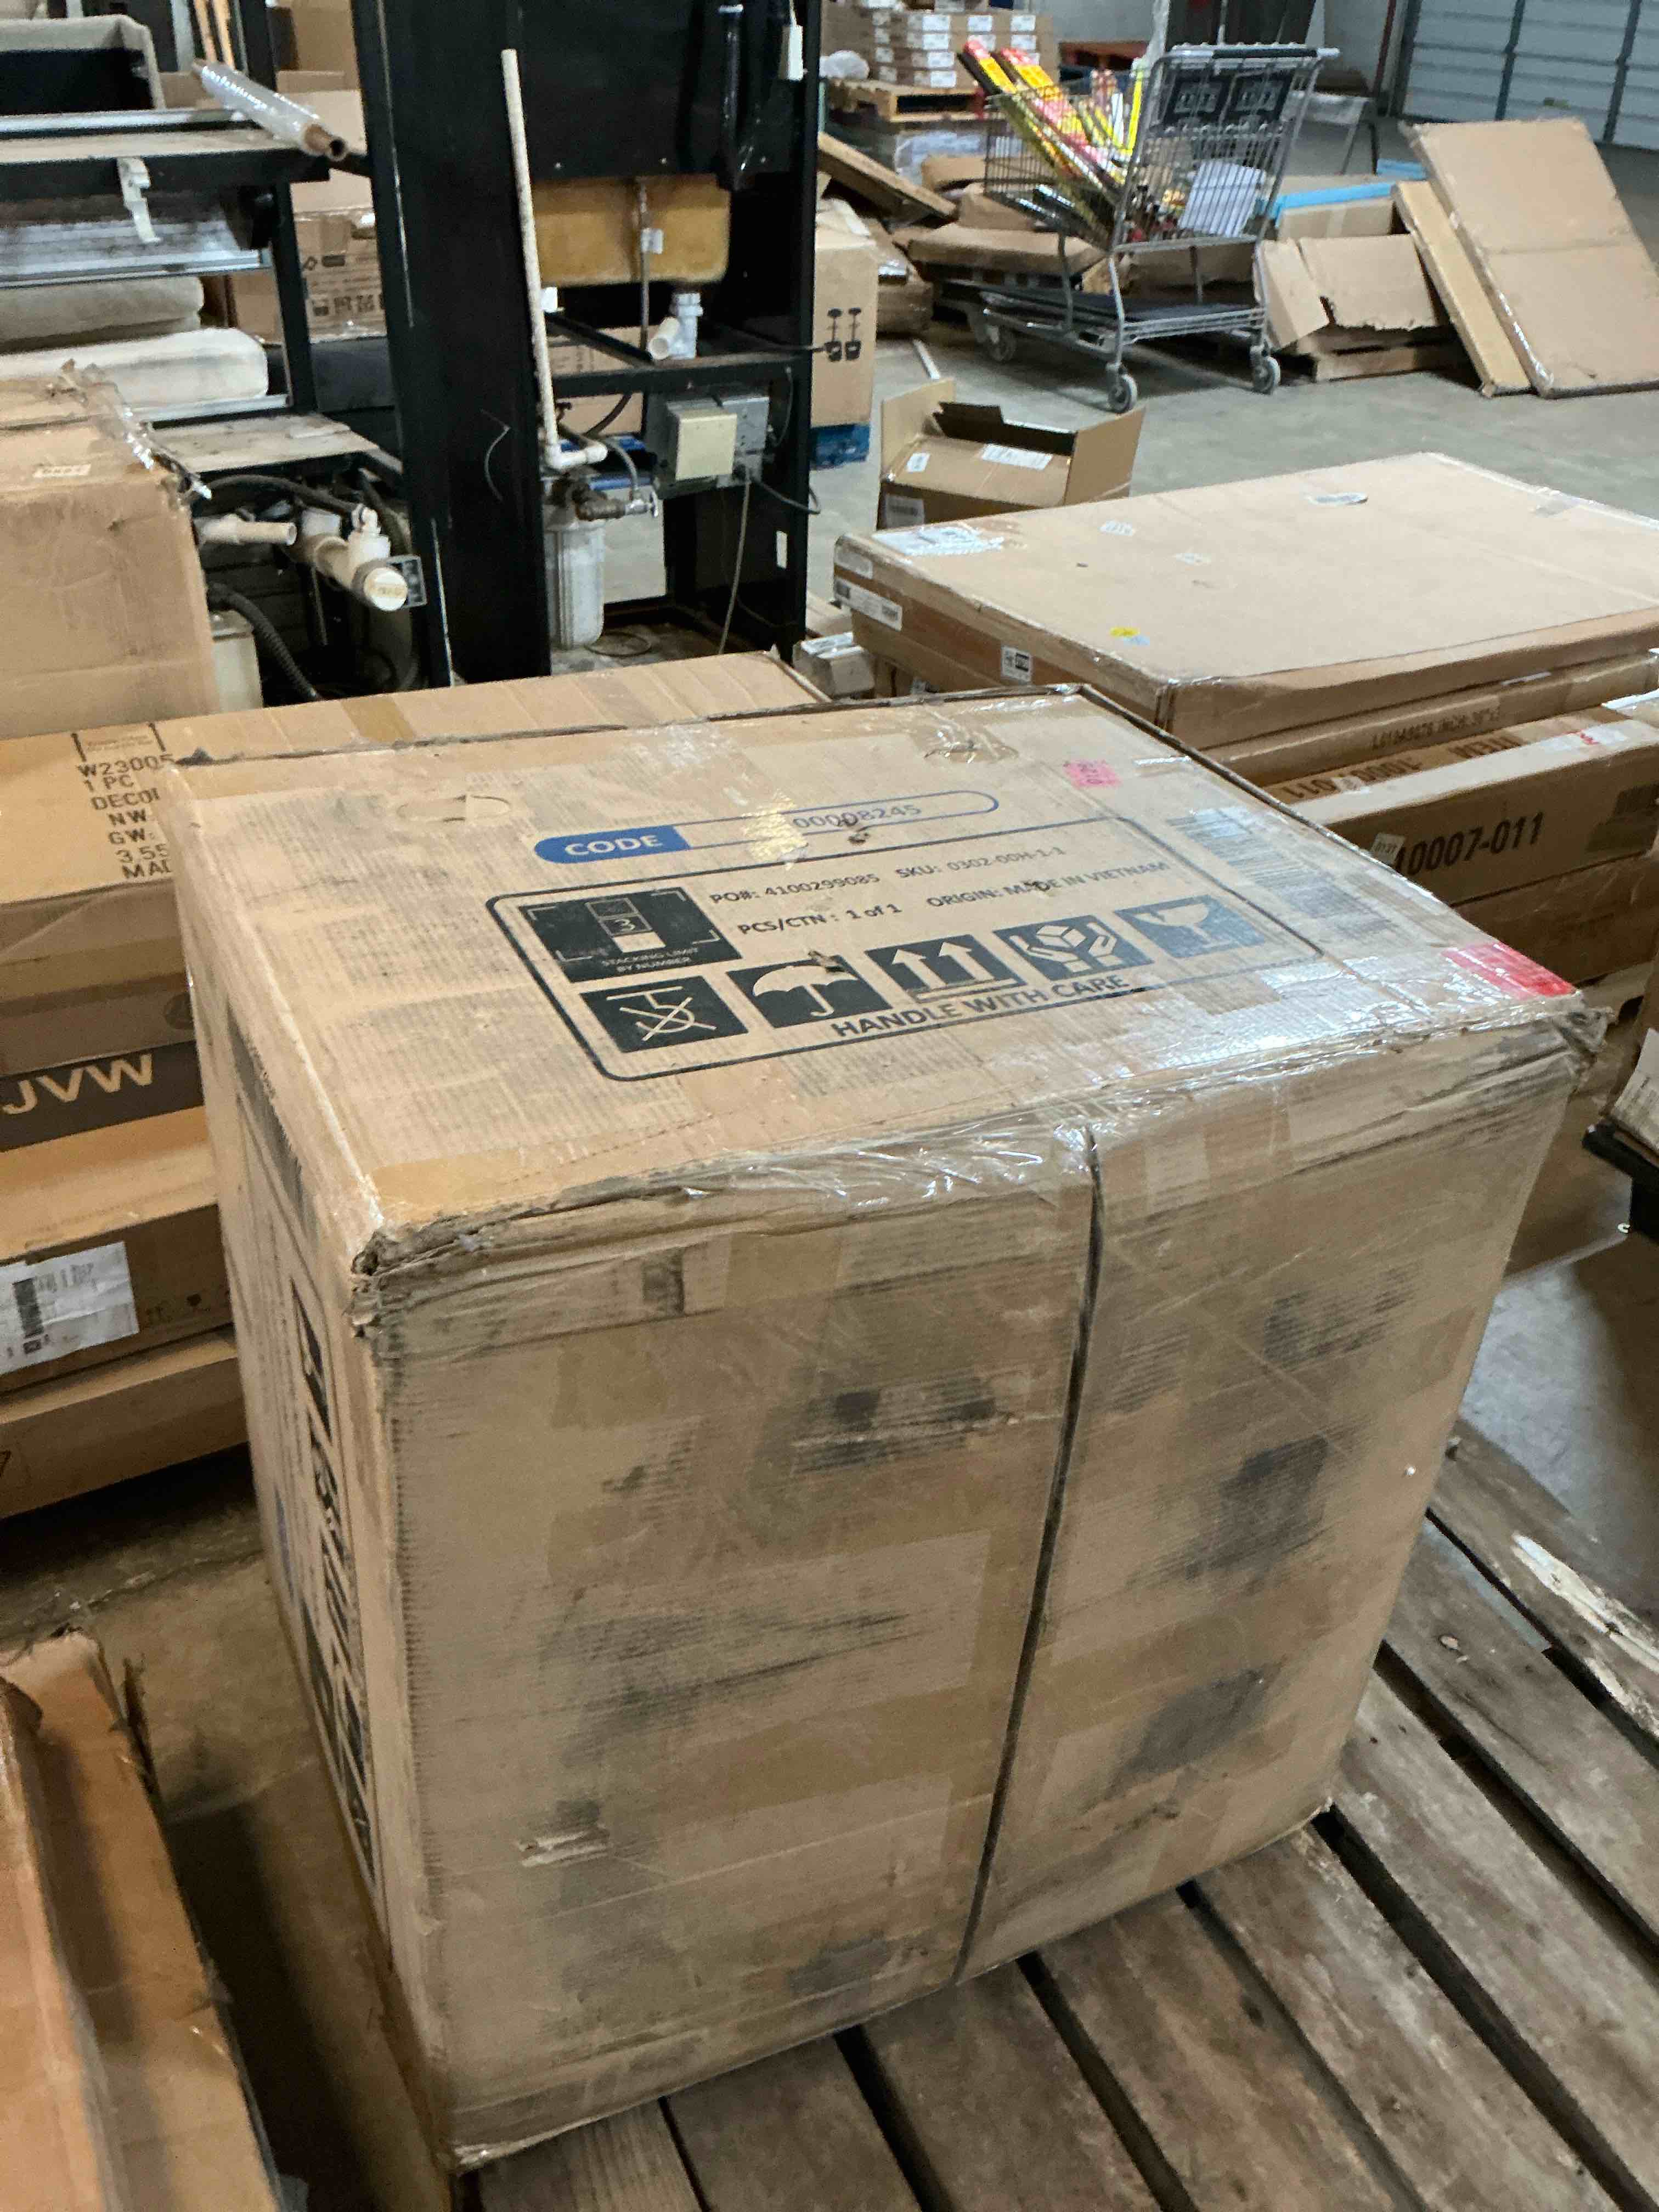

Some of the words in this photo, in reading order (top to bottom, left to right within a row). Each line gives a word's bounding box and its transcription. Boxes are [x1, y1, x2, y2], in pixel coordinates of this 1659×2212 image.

[103, 775, 135, 790] PC
[565, 834, 664, 856] CODE
[710, 889, 761, 903] PO#:
[896, 864, 943, 878] SKU:
[845, 910, 861, 919] 1
[865, 905, 885, 917] of
[887, 903, 902, 913] 1
[926, 889, 1003, 907] ORIGIN:
[1003, 878, 1062, 894] MADE
[1063, 876, 1086, 886] IN
[1086, 861, 1171, 881] VIETNAM
[614, 918, 635, 931] 3
[831, 1001, 960, 1037] HANDLE
[962, 989, 1048, 1013] WITH
[1051, 974, 1129, 998] CARE
